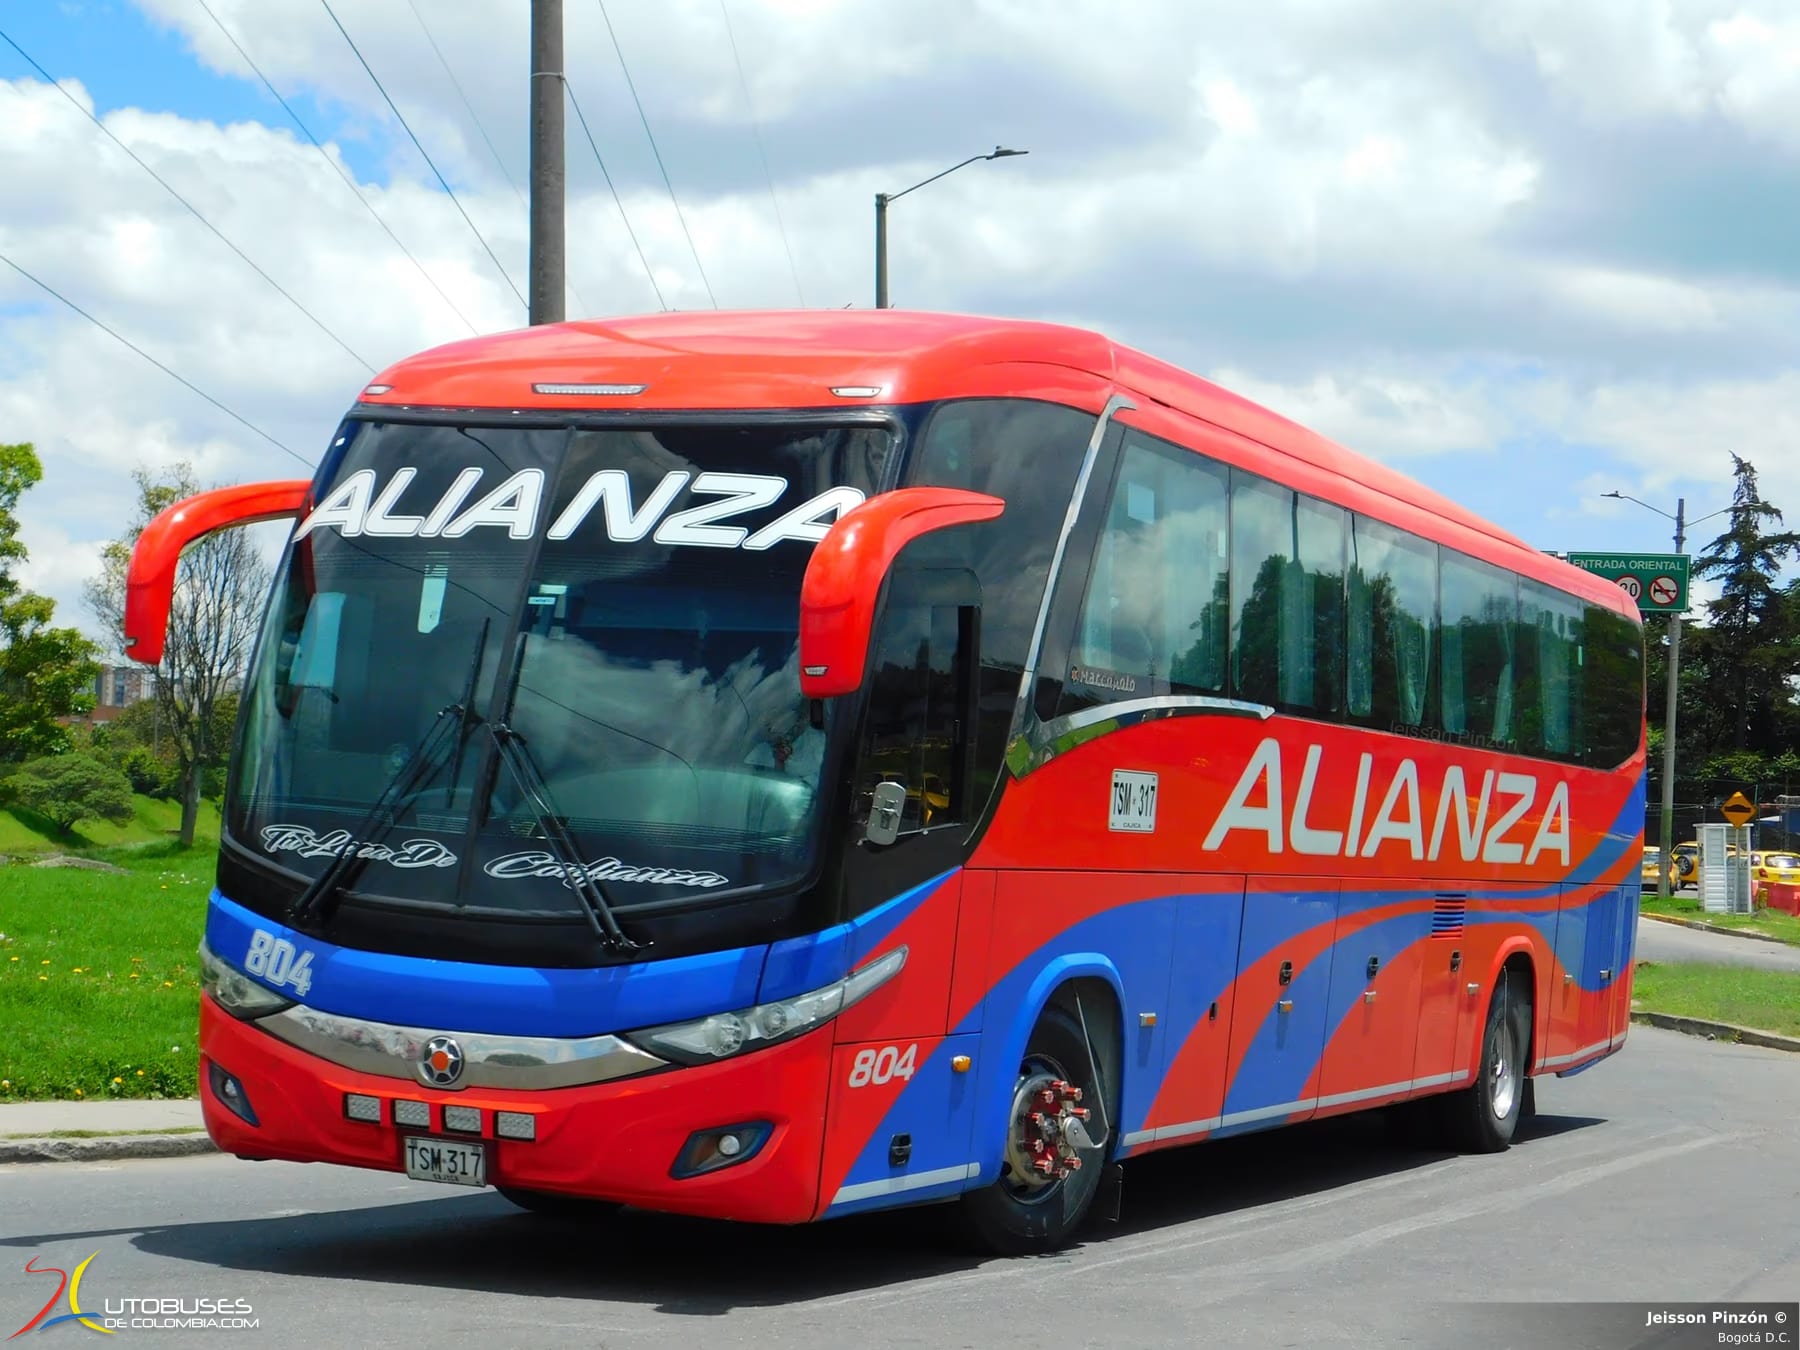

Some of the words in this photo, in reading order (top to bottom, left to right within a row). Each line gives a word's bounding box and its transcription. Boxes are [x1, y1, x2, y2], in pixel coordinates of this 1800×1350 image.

[292, 467, 866, 550] ALIANZA
[1574, 559, 1627, 570] ENTRADA
[1629, 560, 1683, 571] ORIENTAL
[1201, 737, 1570, 867] ALIANZA
[387, 838, 458, 868] De
[484, 850, 729, 889] Confianza
[244, 928, 316, 997] 804
[848, 1043, 918, 1089] 804
